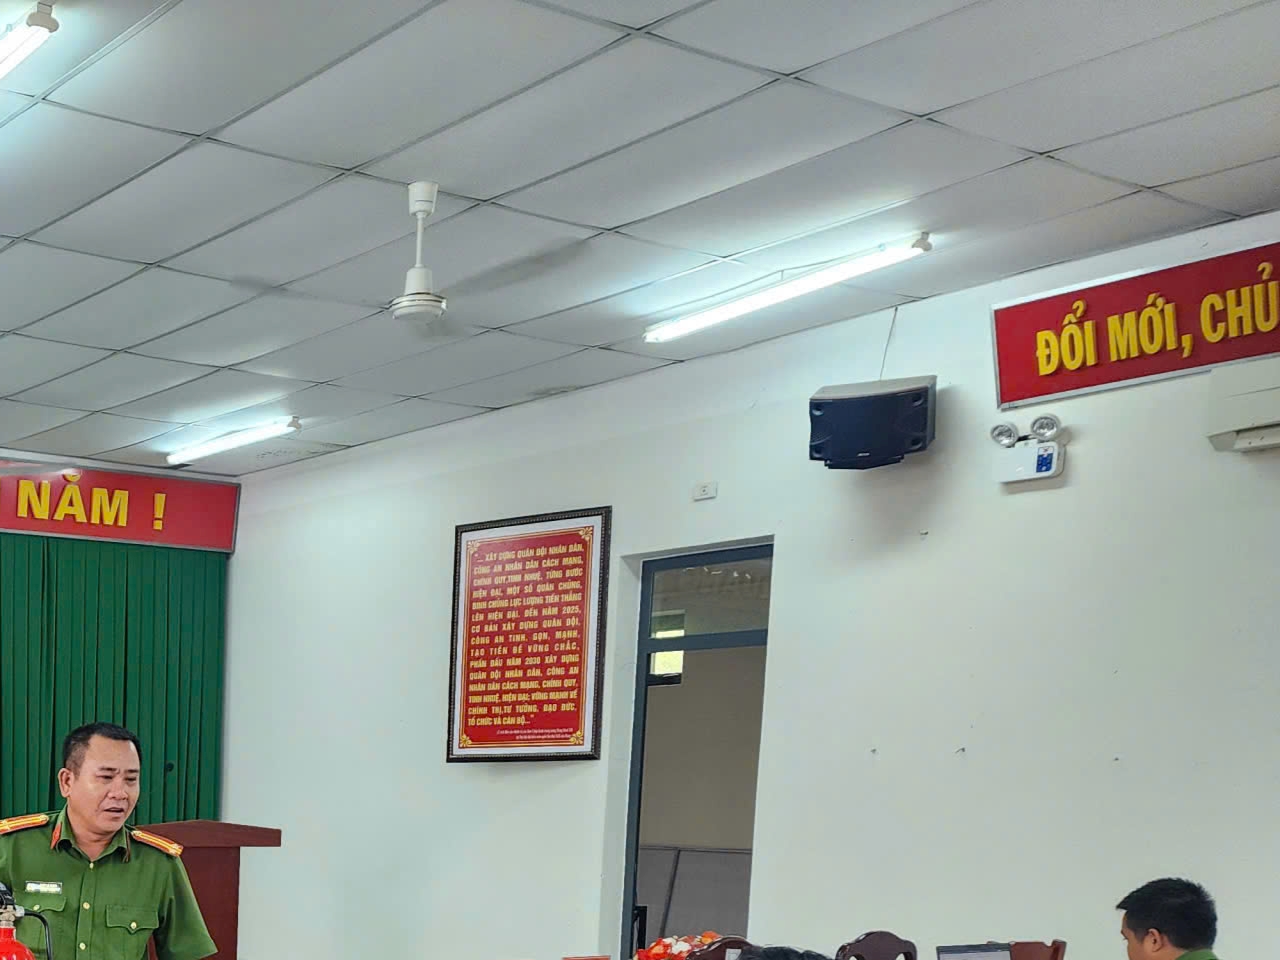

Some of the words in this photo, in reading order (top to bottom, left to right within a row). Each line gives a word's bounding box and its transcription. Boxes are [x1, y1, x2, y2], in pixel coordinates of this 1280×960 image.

[1036, 300, 1098, 376] ĐỔI
[1107, 293, 1193, 358] MỚI,
[1200, 262, 1280, 343] CHỦ
[17, 470, 129, 527] NĂM
[493, 564, 502, 572] AN
[525, 559, 539, 569] DÂN
[542, 558, 559, 567] CÁCH
[524, 583, 533, 593] SỐ
[472, 612, 484, 621] LÊN
[524, 607, 538, 617] ĐẾN
[502, 621, 516, 631] XÂY
[542, 618, 562, 628] QUÂN
[471, 635, 490, 645] CÔNG
[494, 635, 504, 643] AN
[471, 648, 485, 657] TẠO
[525, 657, 541, 665] 2030
[544, 654, 557, 664] XÂY
[470, 671, 487, 680] QUÂN
[505, 668, 523, 678] NHÂN
[547, 666, 565, 675] CÔNG
[568, 666, 579, 674] AN
[502, 680, 518, 690] CÁCH
